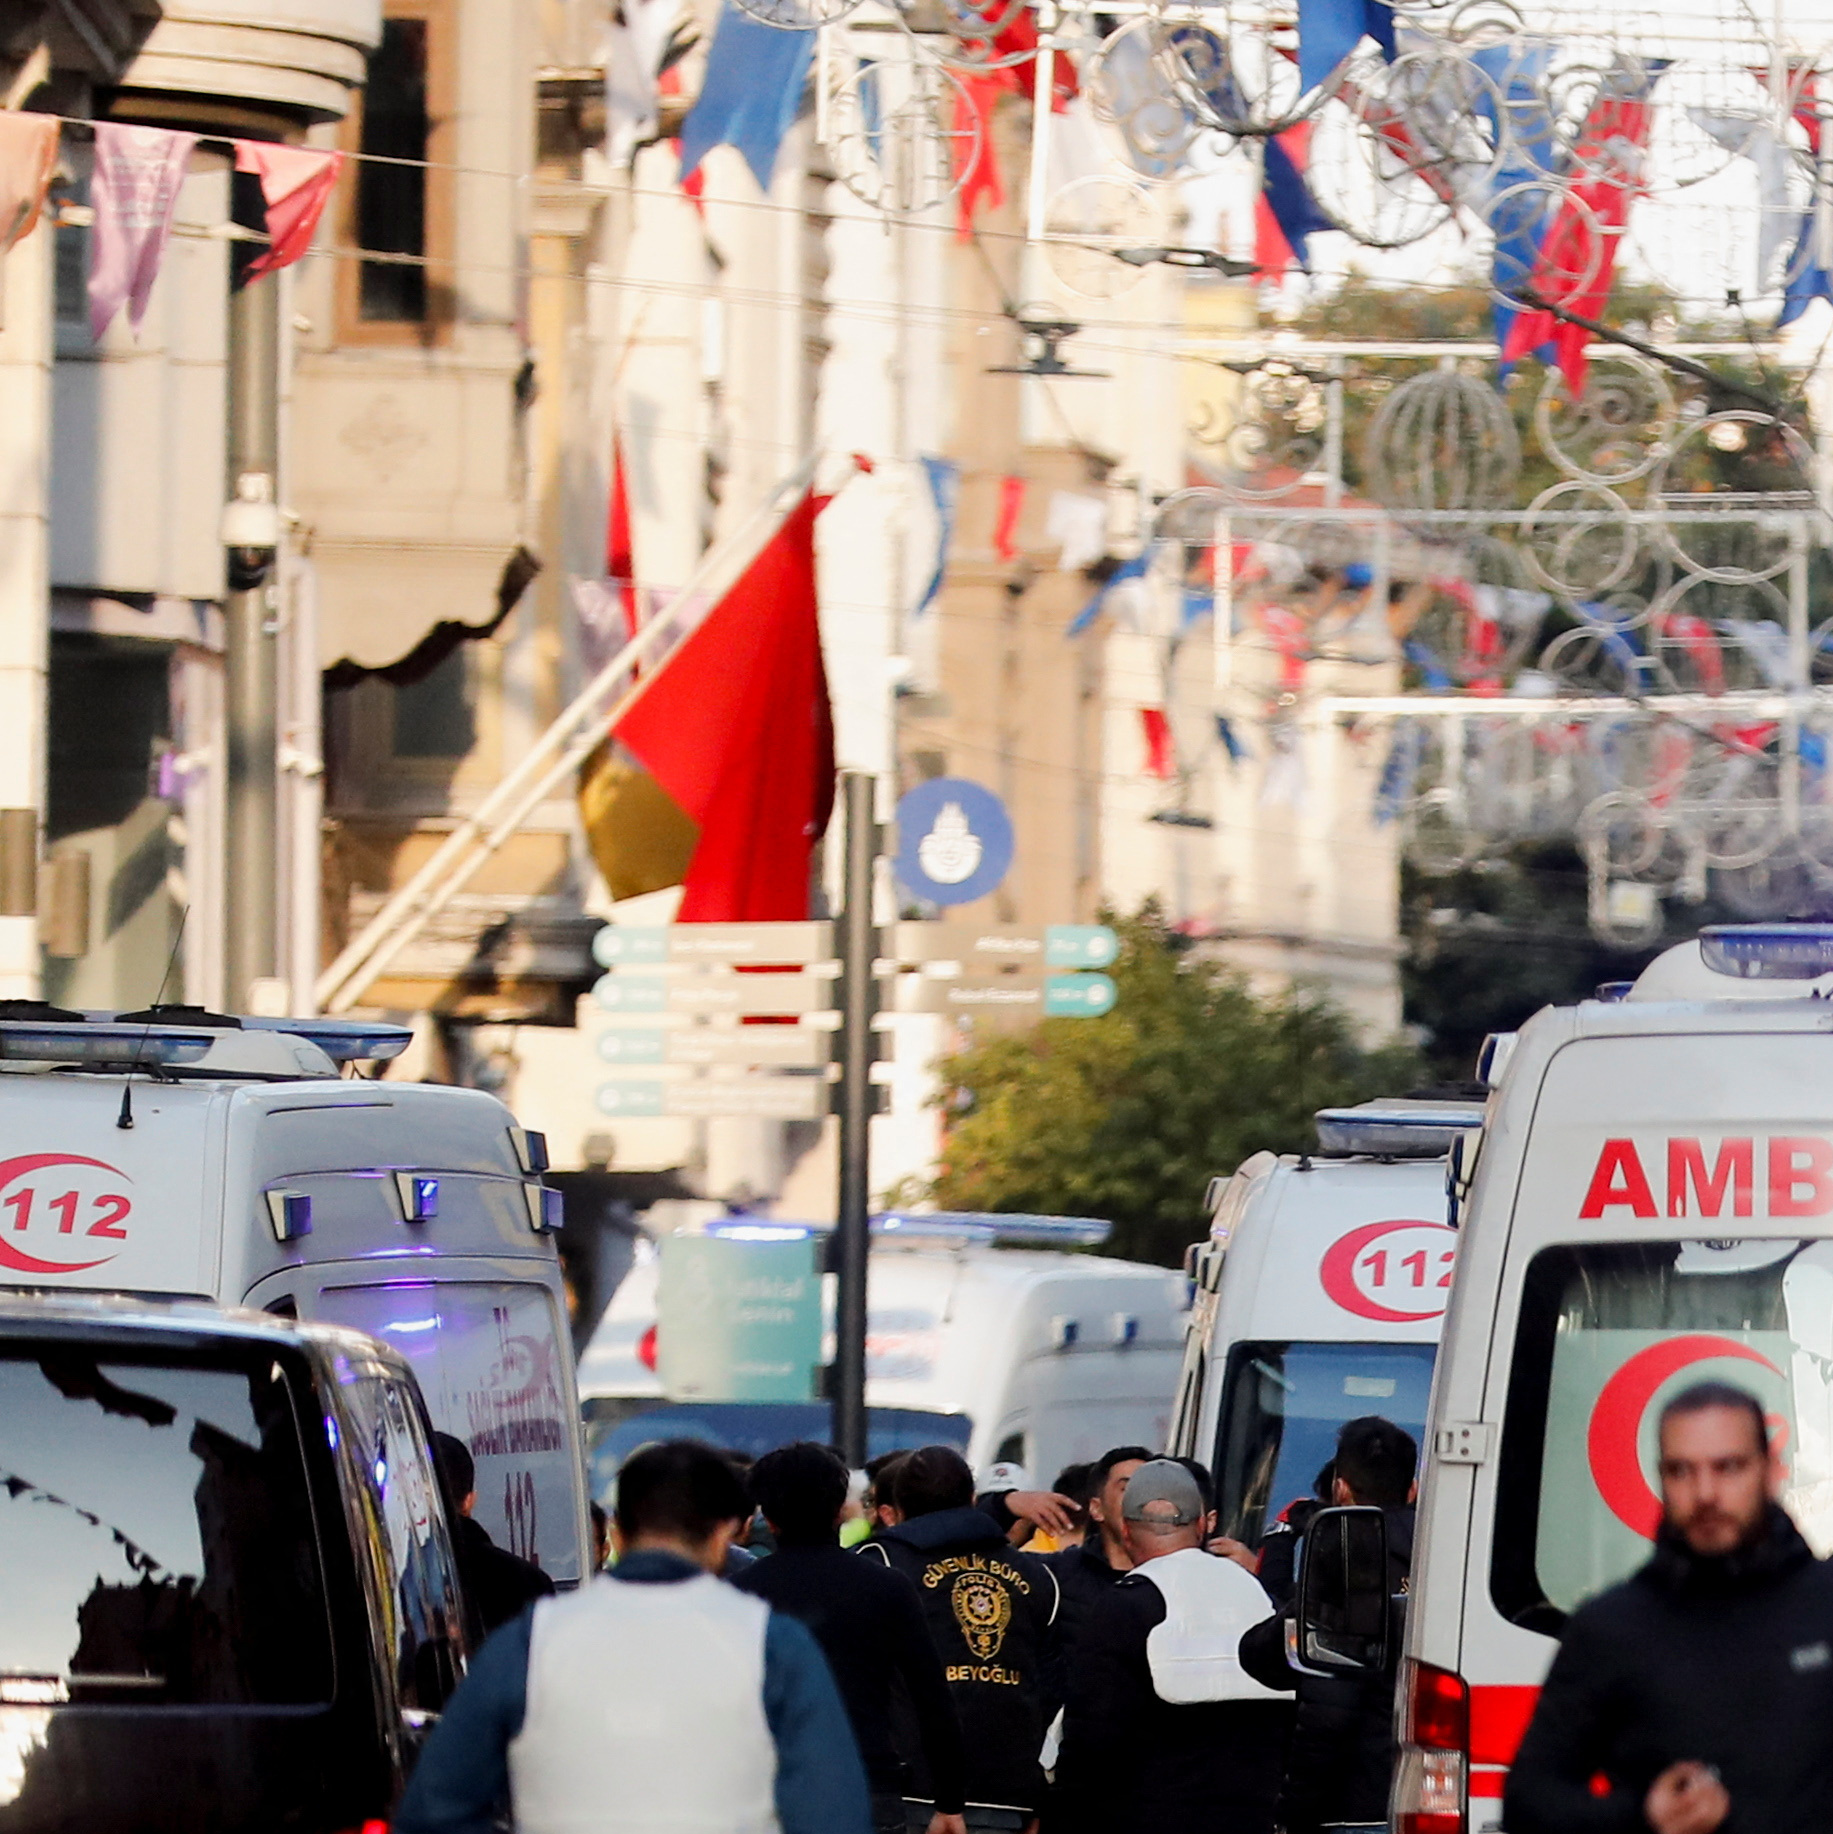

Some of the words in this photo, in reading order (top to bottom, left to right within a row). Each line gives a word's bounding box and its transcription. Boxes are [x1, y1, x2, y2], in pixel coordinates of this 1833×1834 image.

[3, 1187, 131, 1240] 112
[921, 1552, 988, 1589] GÜVENLİK
[989, 1559, 1031, 1596] BÜRO
[945, 1662, 1020, 1686] BEYOĞLU
